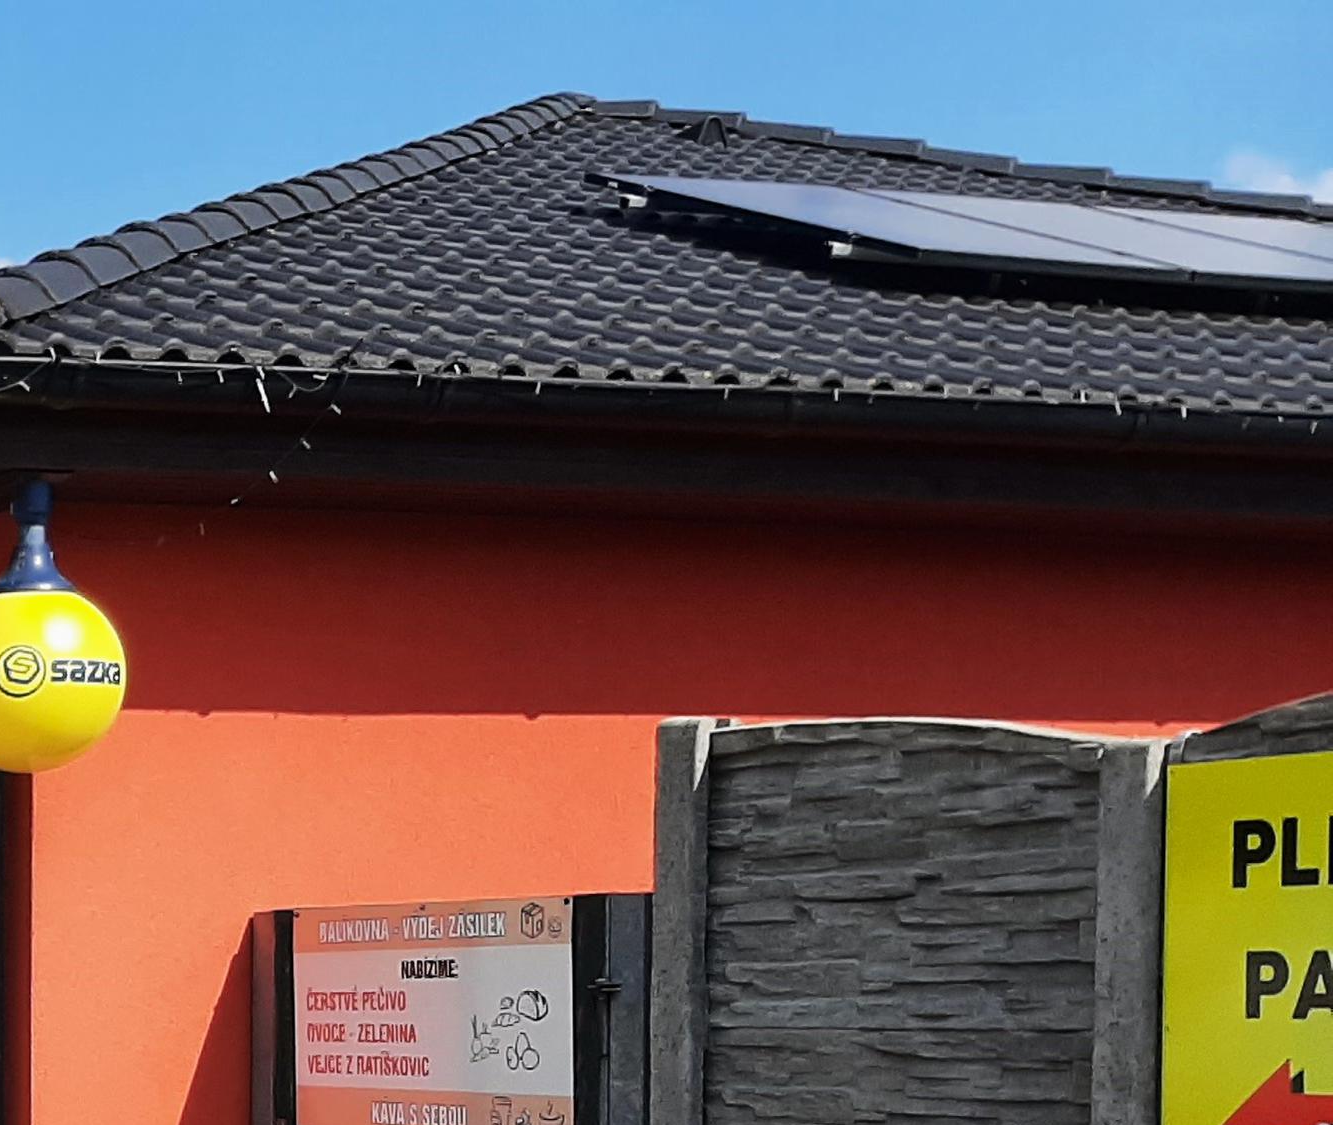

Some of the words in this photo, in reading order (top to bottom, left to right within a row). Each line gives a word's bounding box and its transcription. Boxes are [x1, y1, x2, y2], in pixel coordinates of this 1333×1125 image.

[1233, 816, 1333, 888] PL
[402, 910, 443, 940] VÝDEJ
[448, 907, 507, 938] ZÁSILEK
[306, 986, 358, 1011] ČERSTVÉ
[362, 987, 406, 1011] PEČIVO
[307, 1023, 346, 1043] OVOCE
[357, 1023, 417, 1043] ZELENINA
[307, 1055, 342, 1074] VEJCE
[346, 1056, 353, 1074] Z
[371, 1096, 405, 1125] KÁVA
